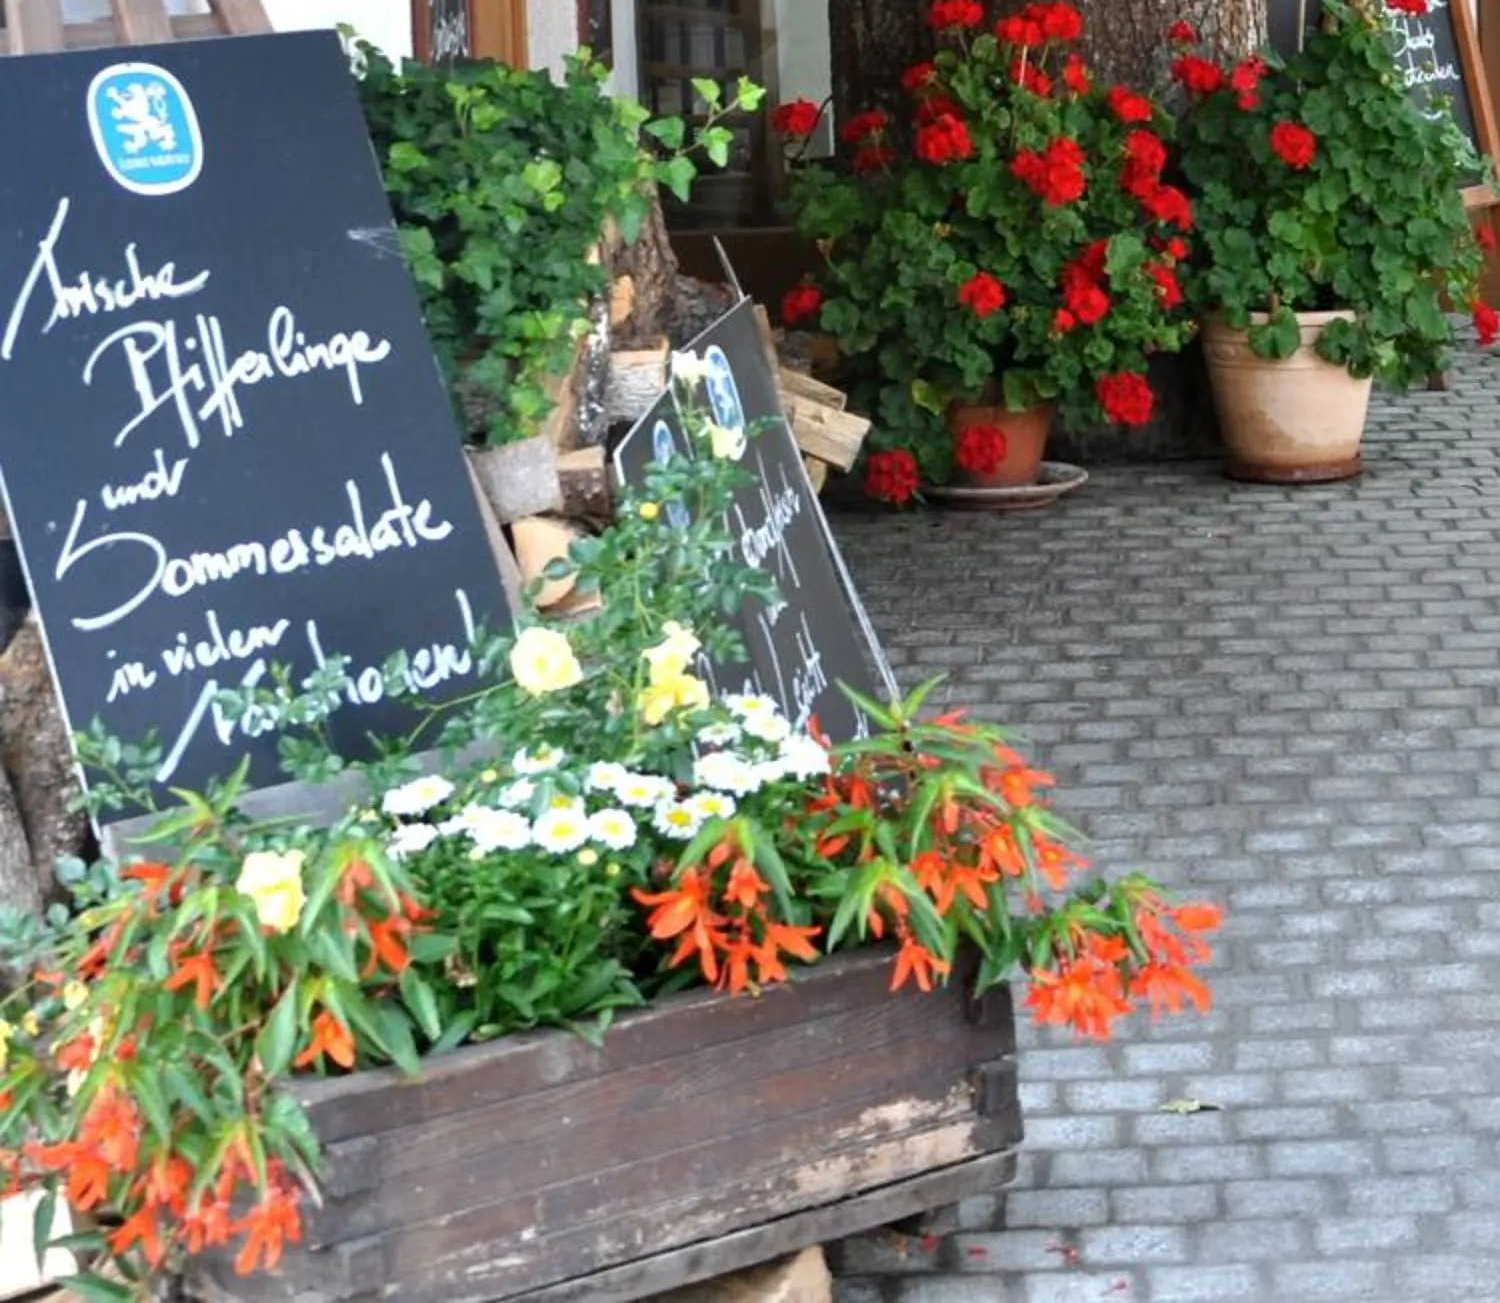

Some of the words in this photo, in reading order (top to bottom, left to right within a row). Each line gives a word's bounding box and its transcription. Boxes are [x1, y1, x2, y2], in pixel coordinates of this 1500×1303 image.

[100, 448, 189, 510] und
[54, 451, 453, 631] Sommersalate
[105, 649, 157, 703] in
[162, 609, 290, 676] vielen
